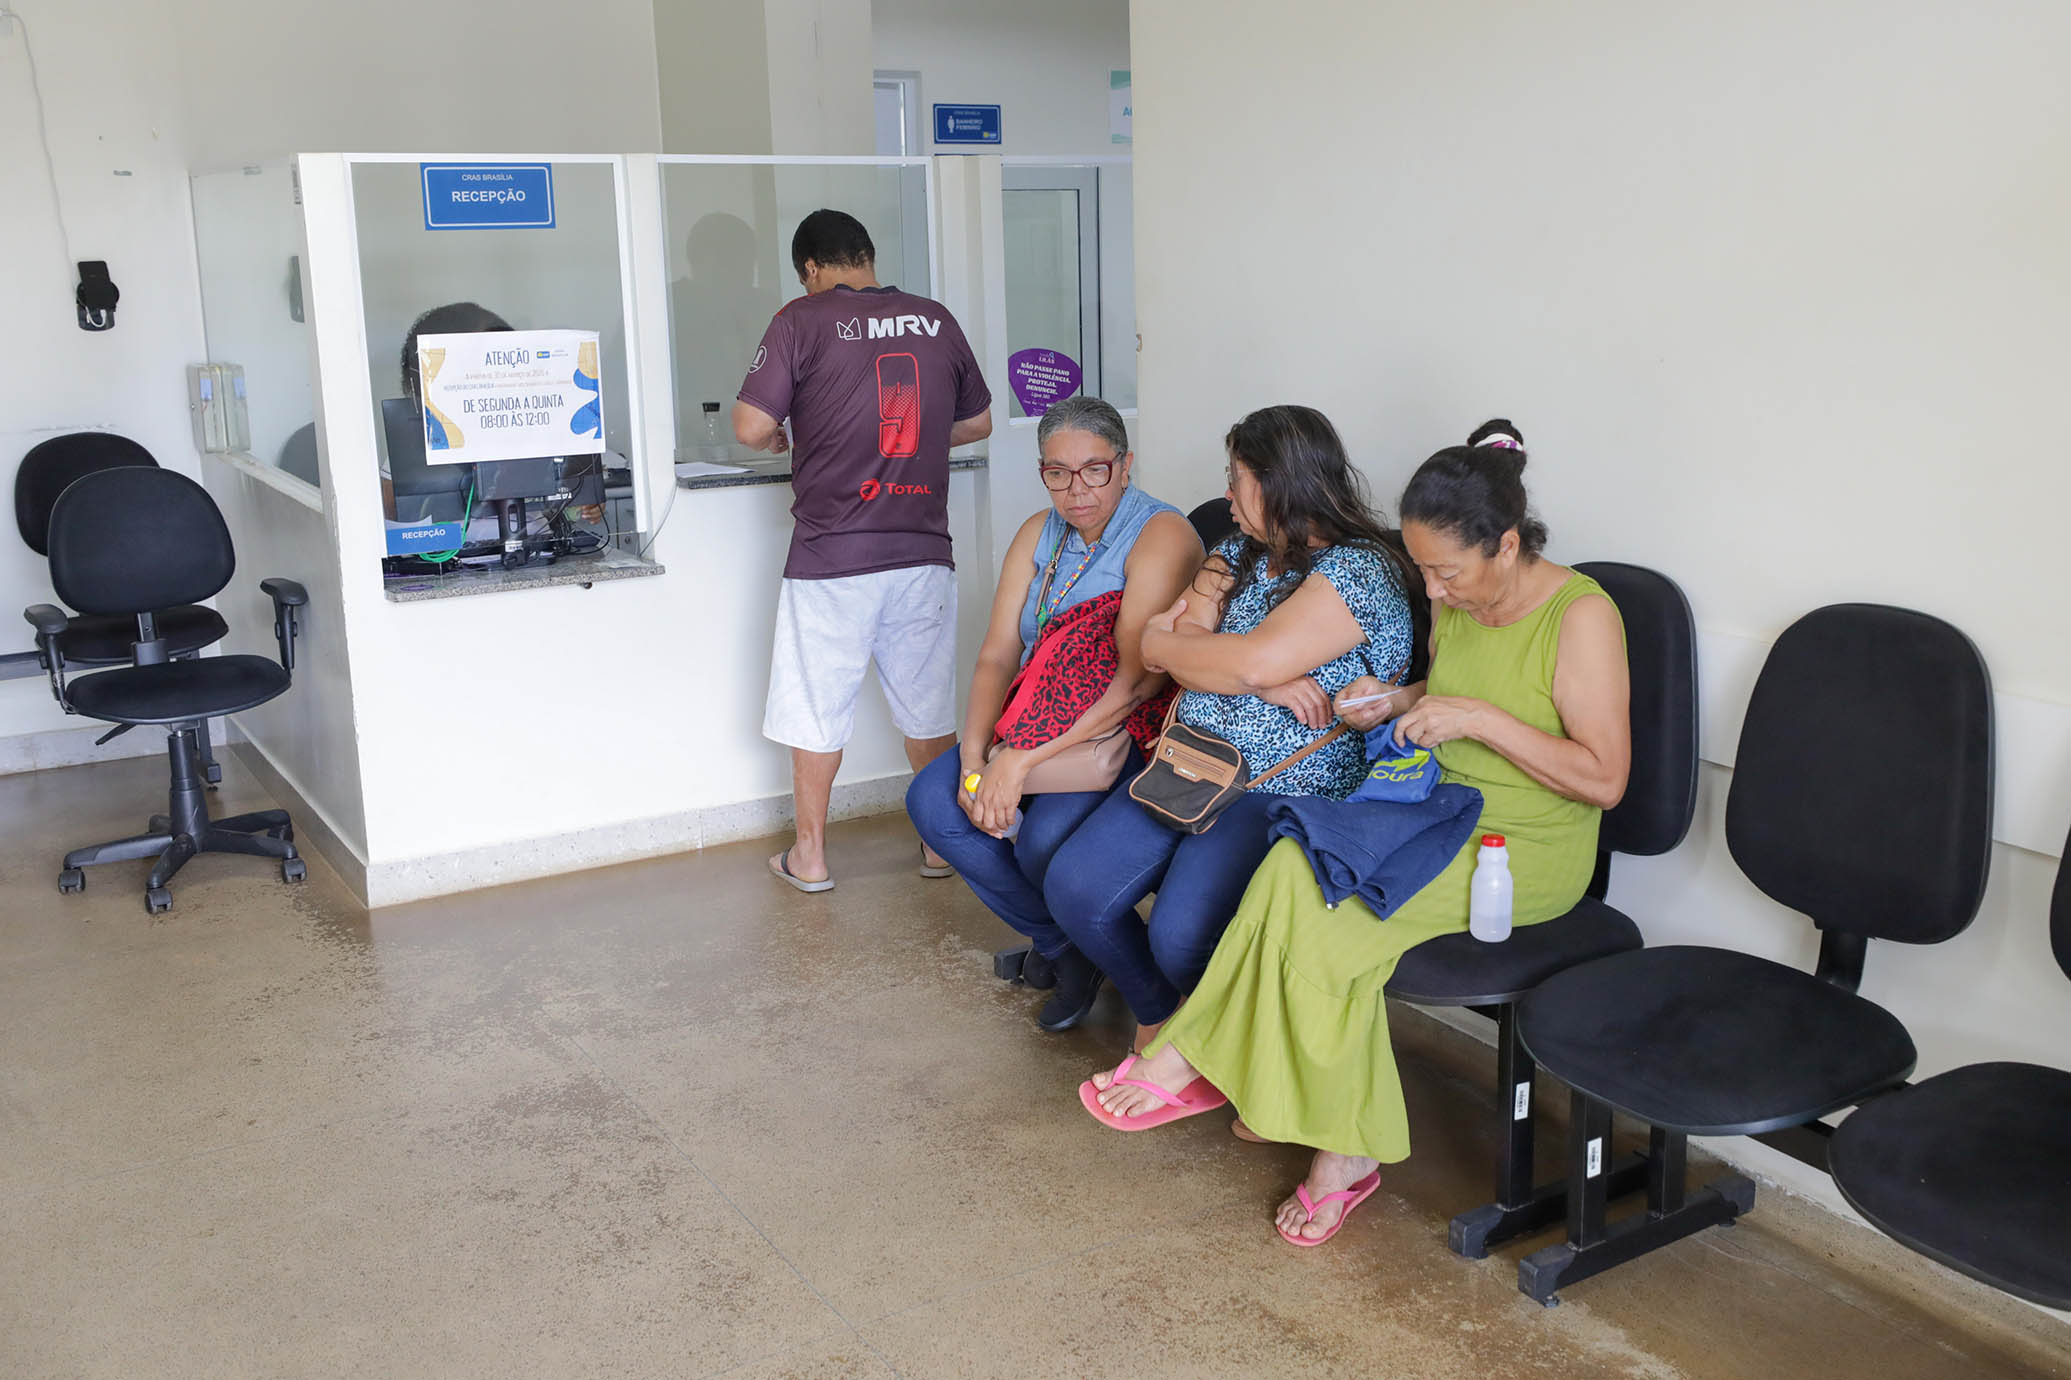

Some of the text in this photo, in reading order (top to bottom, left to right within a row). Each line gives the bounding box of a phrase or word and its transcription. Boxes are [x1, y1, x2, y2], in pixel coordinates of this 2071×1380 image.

[482, 173, 513, 181] BRASÍLIA
[451, 188, 526, 204] RECEPÇÃO
[867, 315, 941, 339] MRV
[485, 348, 530, 368] ATENÇÃO
[1016, 368, 1033, 377] PARA
[1021, 362, 1034, 370] NÃO
[1034, 364, 1053, 373] PASSE
[463, 394, 564, 414] DE SEGUNDA A QUINTA
[876, 352, 920, 458] 9
[480, 411, 550, 429] 08:00 ÀS 12:00
[402, 528, 446, 539] RECEPÇÃO
